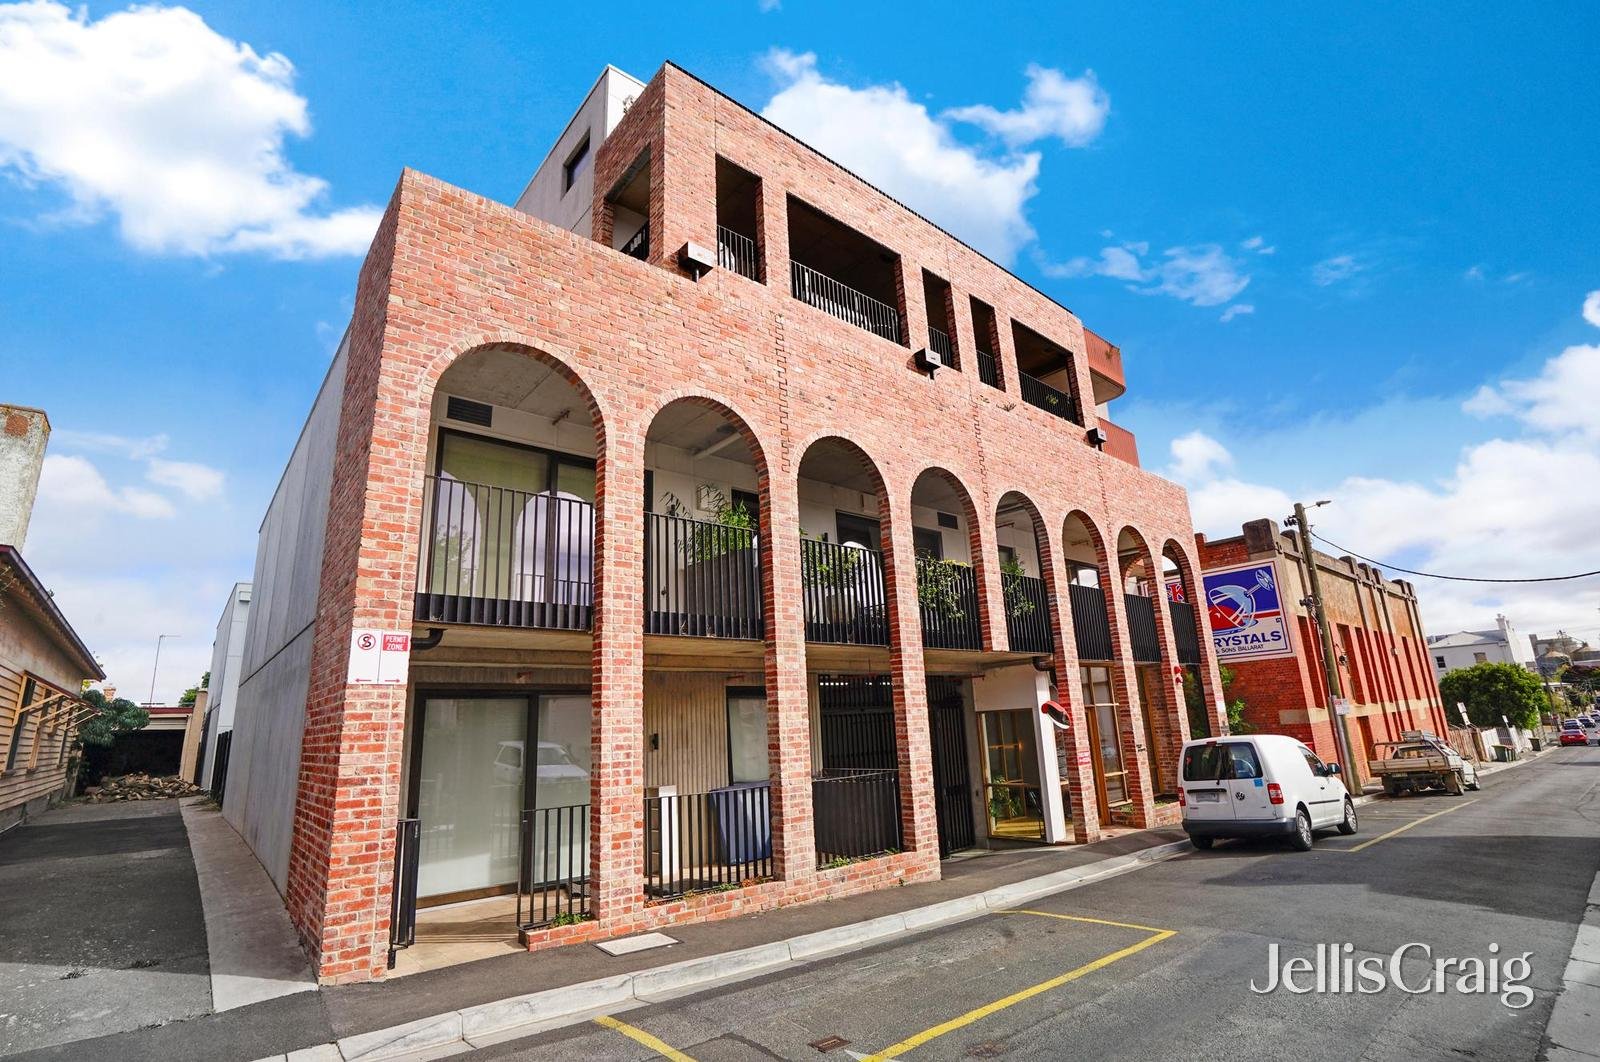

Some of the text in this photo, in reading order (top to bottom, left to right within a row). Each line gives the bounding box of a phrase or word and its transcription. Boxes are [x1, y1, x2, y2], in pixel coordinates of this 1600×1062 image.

[385, 635, 406, 643] PERMIT
[1213, 630, 1282, 648] RYSTALS
[1237, 644, 1264, 652] BALLARAT
